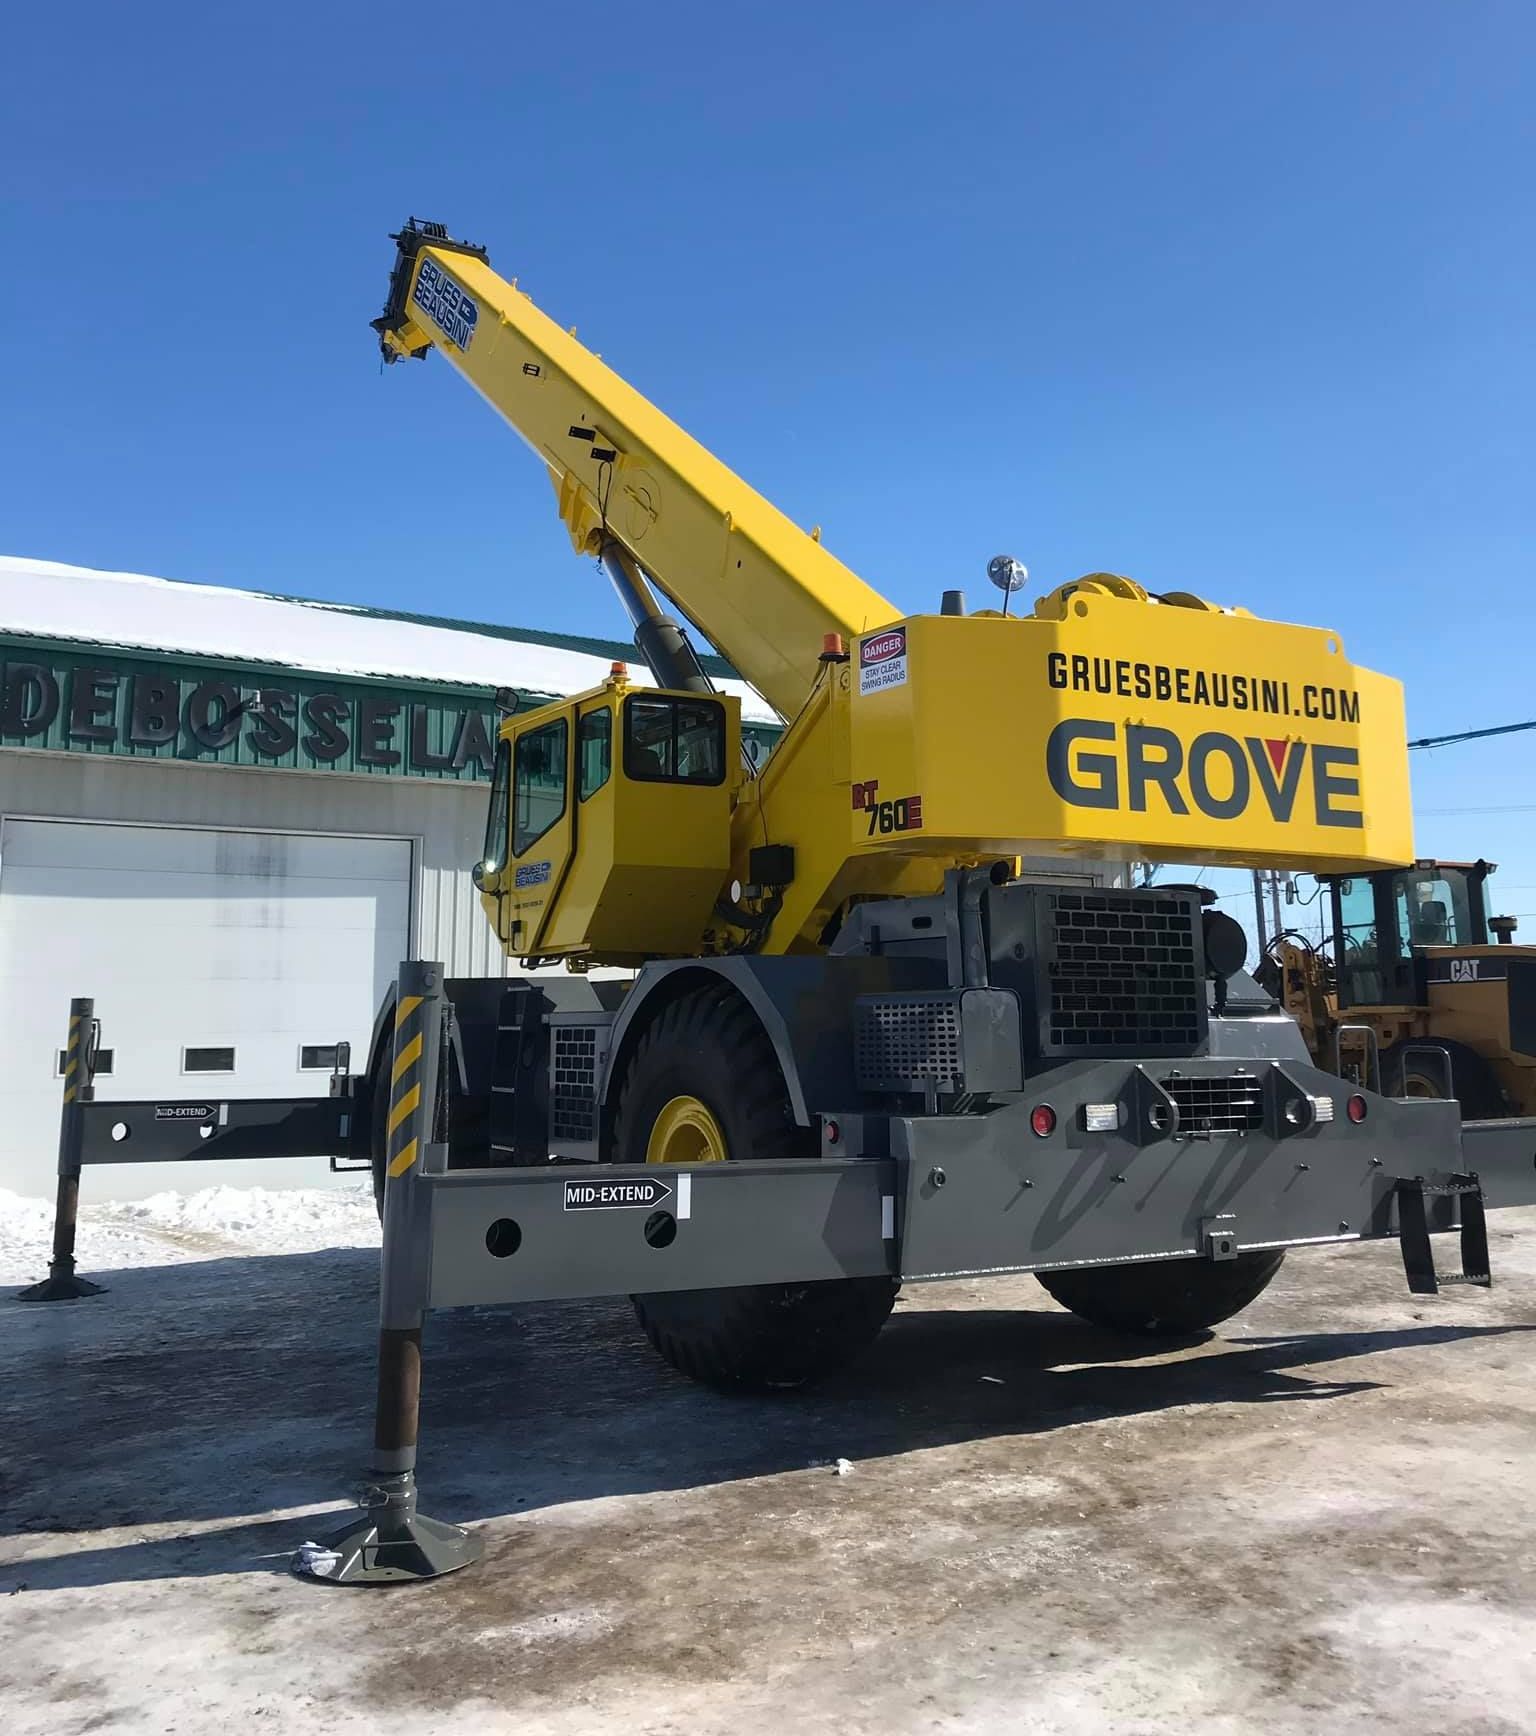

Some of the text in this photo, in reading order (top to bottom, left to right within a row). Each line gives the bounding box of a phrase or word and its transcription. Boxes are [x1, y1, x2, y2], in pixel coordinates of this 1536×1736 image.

[419, 259, 461, 311] GRUES
[414, 282, 470, 348] BEAUSINI
[864, 637, 901, 659] DANGER
[861, 671, 906, 691] SWING RADIUS
[865, 660, 901, 679] STAY CLEAR
[1048, 652, 1360, 724] GRUESBEAUSINI.COM
[1046, 718, 1364, 829] GROVE
[852, 780, 879, 810] RT
[865, 795, 923, 836] 760E
[1450, 960, 1480, 982] CAT
[567, 1185, 654, 1203] MID-EXTEND
